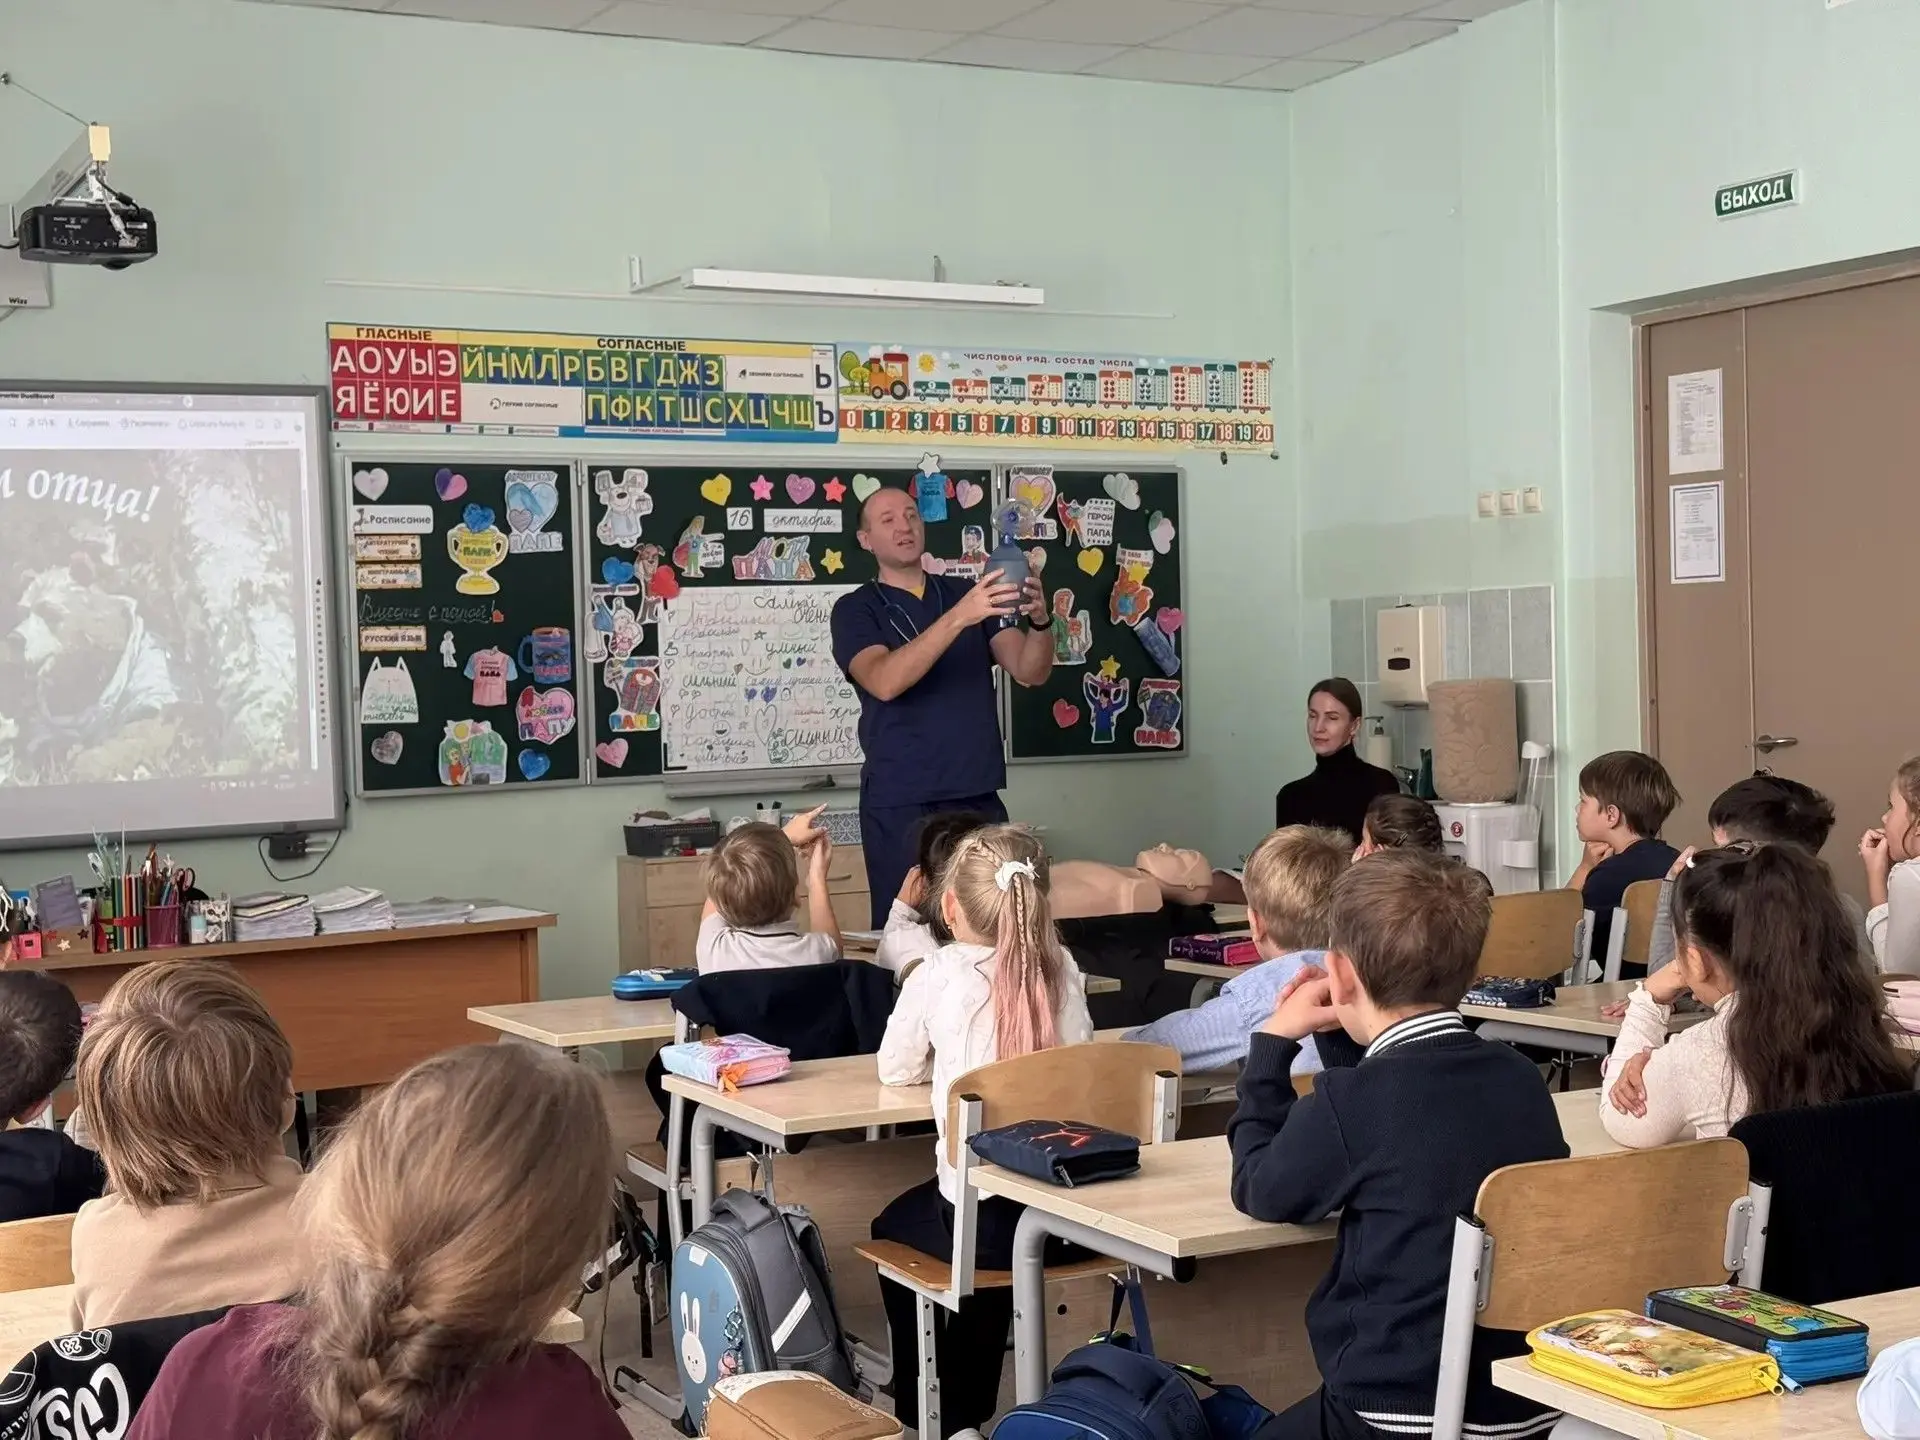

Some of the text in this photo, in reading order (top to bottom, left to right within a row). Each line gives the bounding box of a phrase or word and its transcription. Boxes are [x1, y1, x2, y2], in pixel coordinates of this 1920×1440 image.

[1721, 179, 1786, 211] ВЫХОД
[356, 328, 433, 341] ГЛАСНЫЕ
[597, 338, 686, 351] СОГЛАСНЫЕ
[964, 353, 1134, 367] ЧИСЛОВОЙ РЯД. СОСТАВ ЧИСЛА
[815, 364, 832, 389] Ь
[815, 401, 835, 425] Ъ
[847, 410, 1271, 441] 0 1 2 3 4 5 6 7 8 9 10 11 12 13 14 15 16 17 18 19 20
[27, 467, 160, 523] отца!
[370, 514, 431, 524] Расписание
[729, 509, 751, 527] 16
[1087, 511, 1112, 521] ГЕРОЙ
[1087, 528, 1111, 537] ПАПА
[509, 533, 562, 552] ПАПЕ
[734, 558, 813, 580] ПАПА
[364, 634, 398, 642] РУССКИЙ
[520, 717, 575, 740] ПАПУ
[60, 1337, 82, 1356] 23
